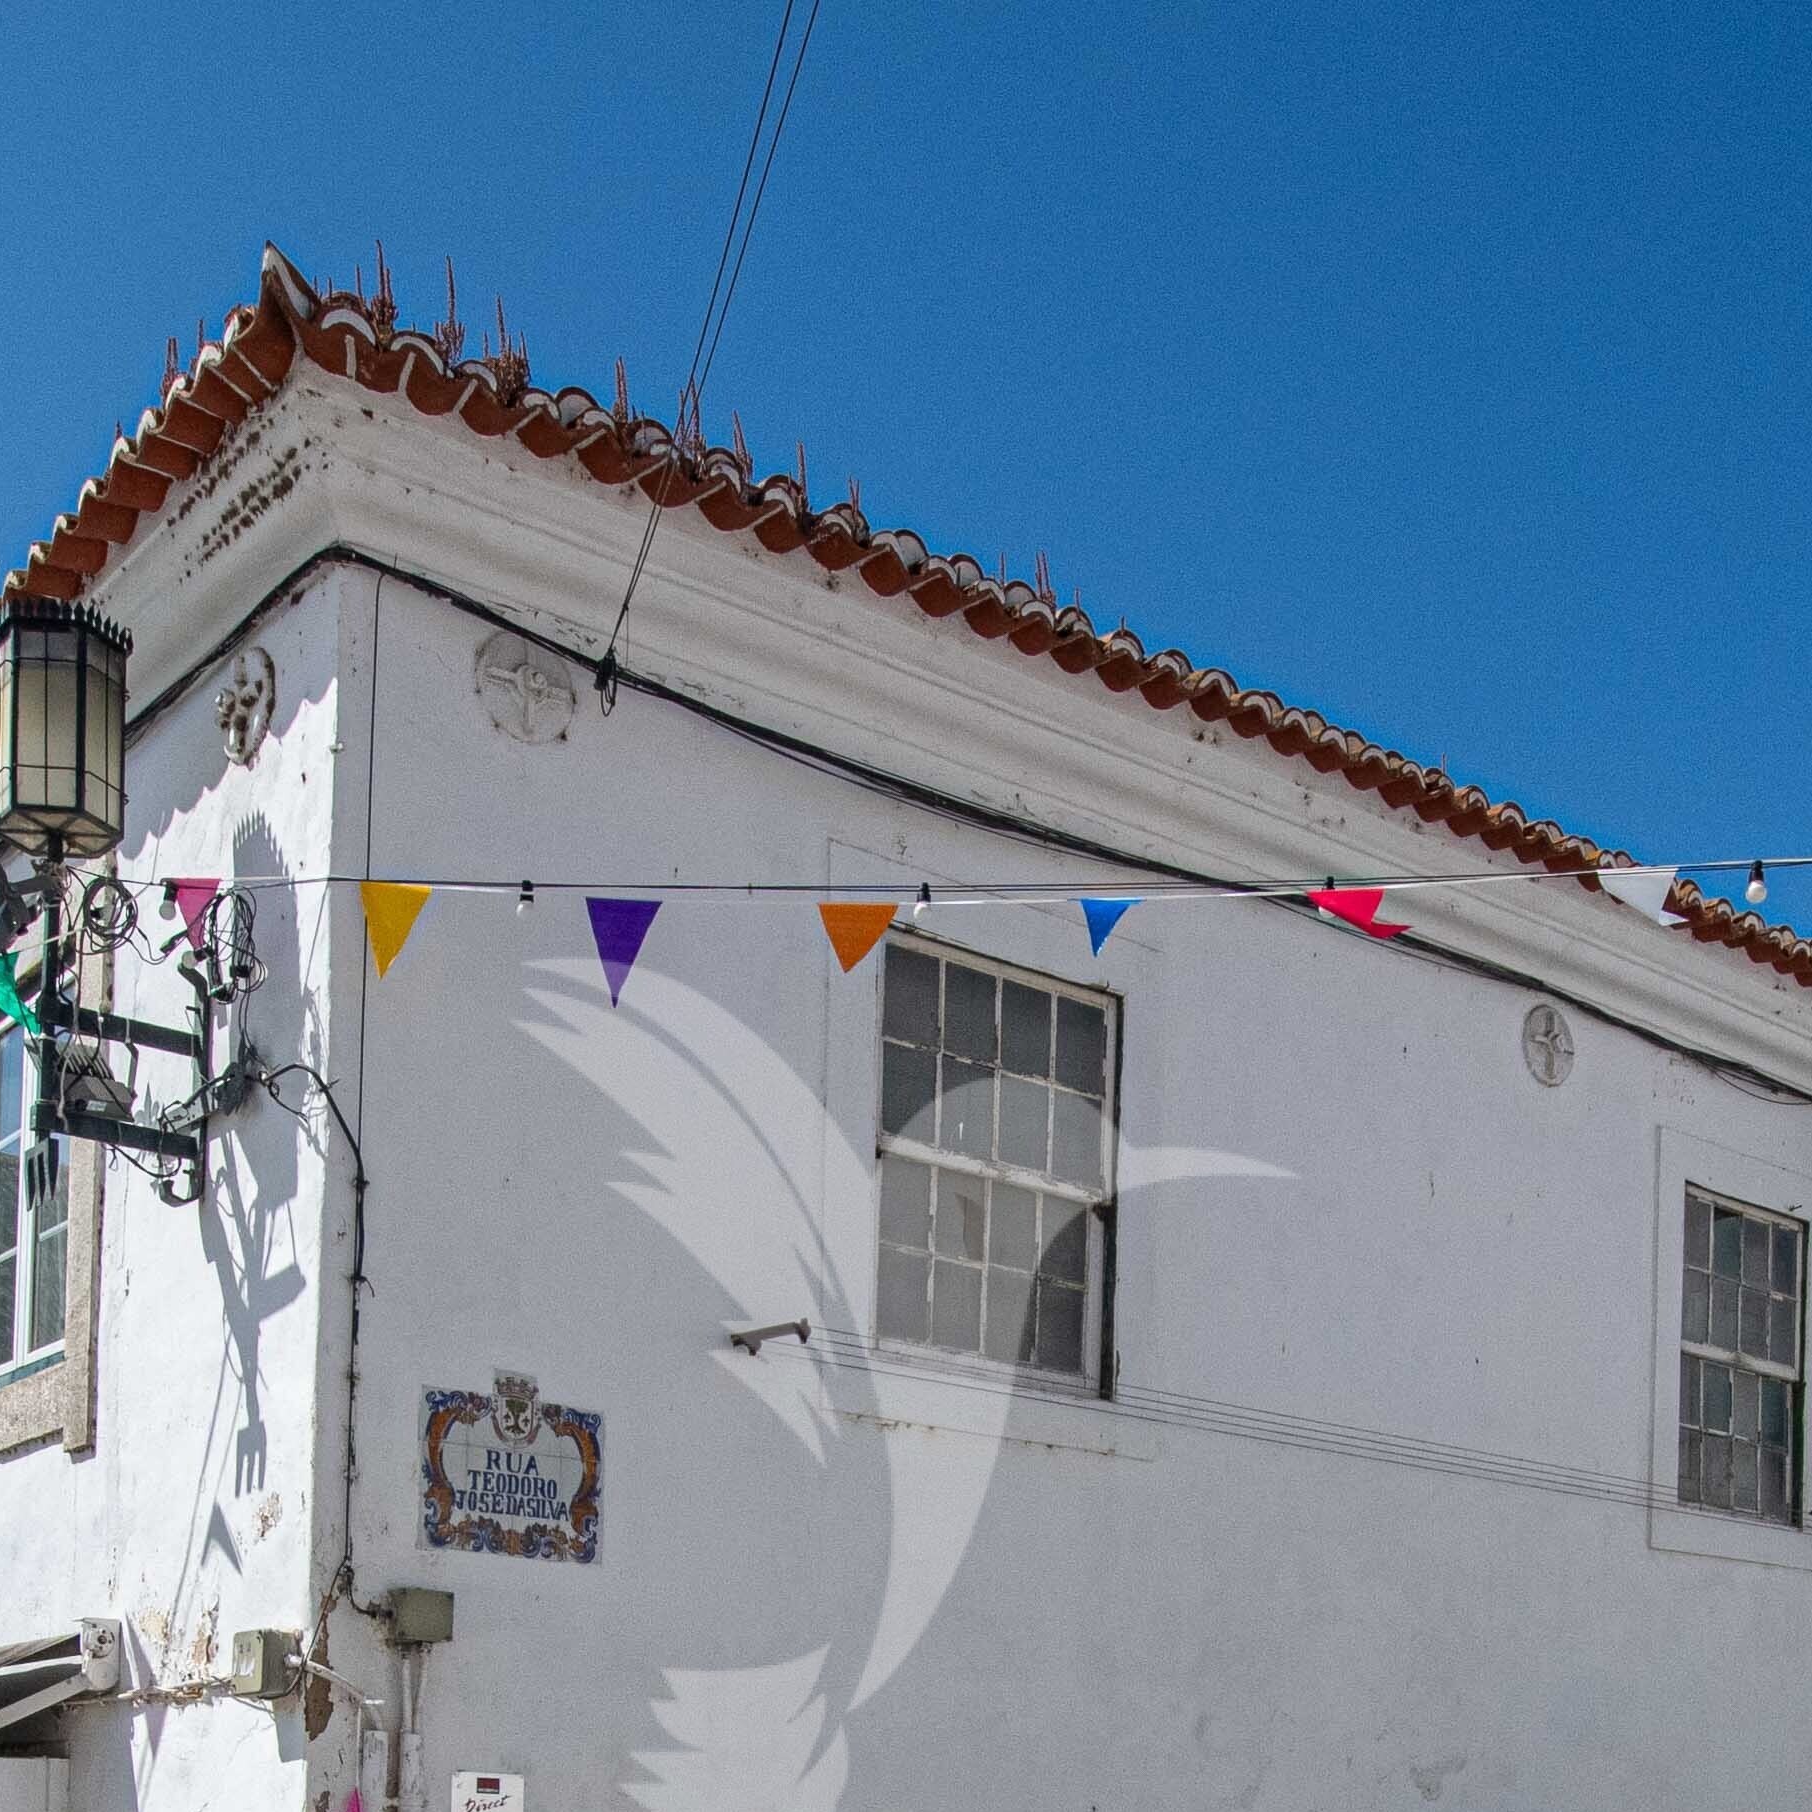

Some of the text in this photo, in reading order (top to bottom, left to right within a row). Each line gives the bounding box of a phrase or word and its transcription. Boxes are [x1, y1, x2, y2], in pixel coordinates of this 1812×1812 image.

[486, 1449, 539, 1476] RUA
[468, 1469, 558, 1500] TEODORO
[506, 1496, 526, 1517] DA
[527, 1498, 569, 1521] SILVA
